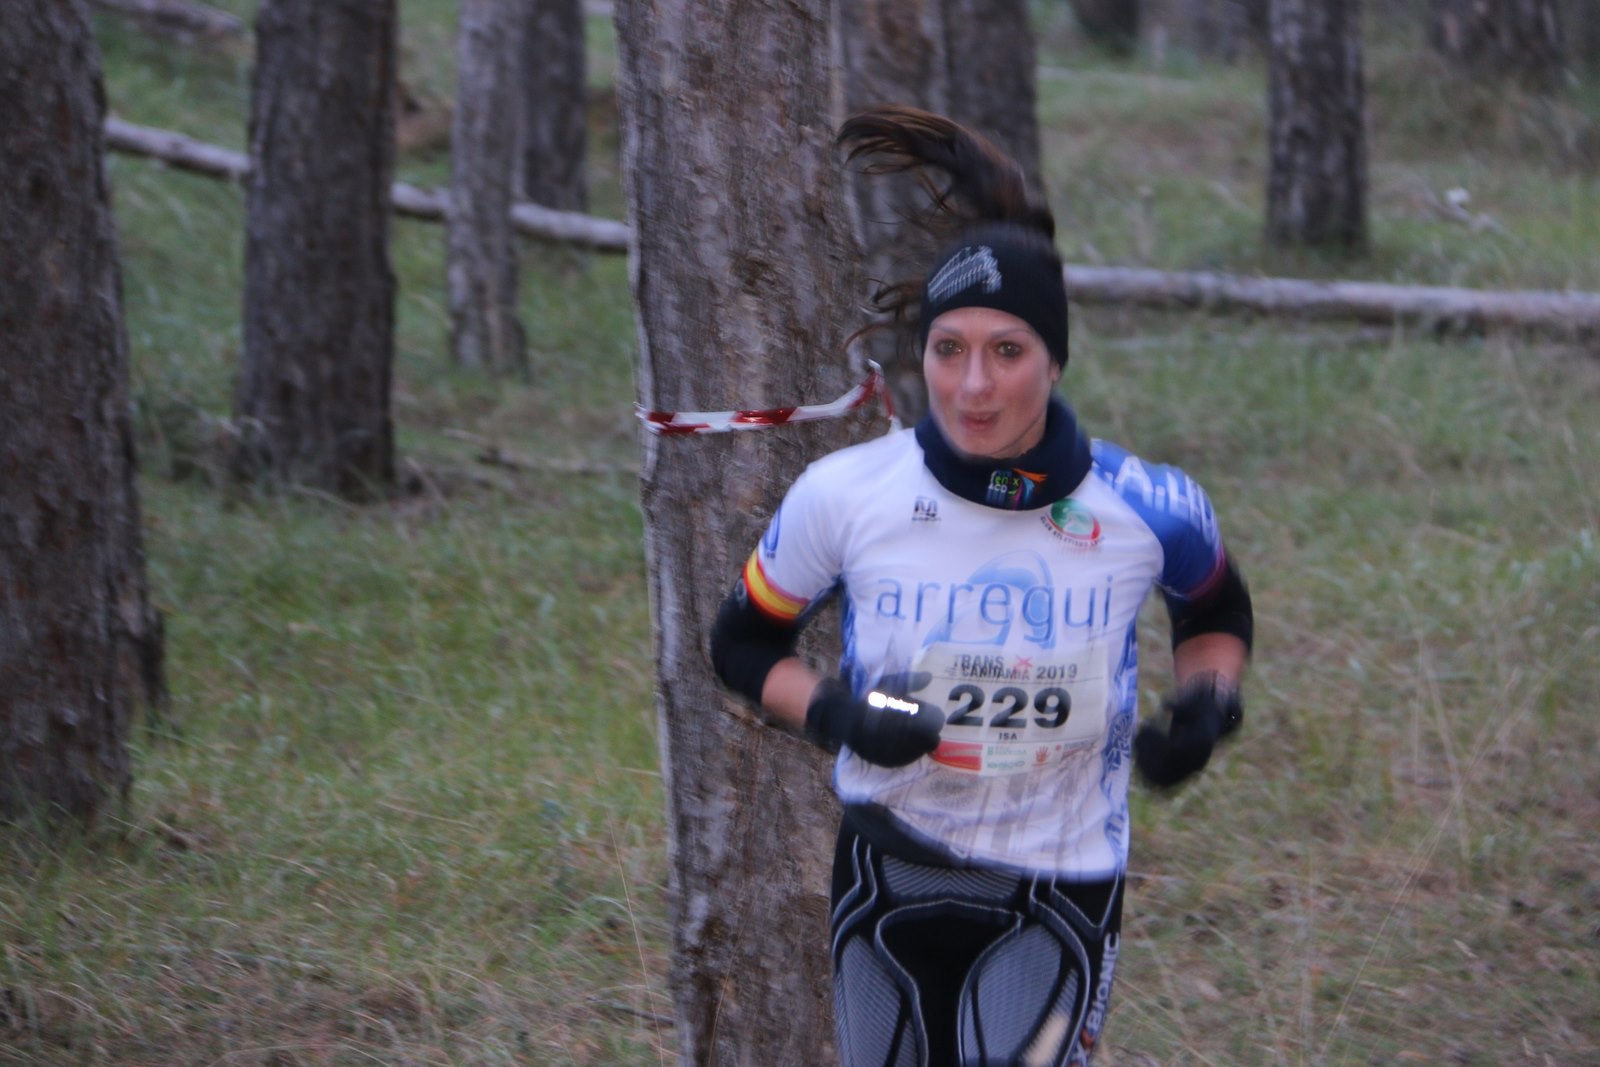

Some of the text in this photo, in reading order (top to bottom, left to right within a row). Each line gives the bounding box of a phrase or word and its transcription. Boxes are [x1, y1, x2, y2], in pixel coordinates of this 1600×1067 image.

[876, 575, 1113, 643] arregui
[1036, 663, 1078, 679] 2019
[946, 684, 1072, 728] 229
[999, 732, 1018, 741] ISA
